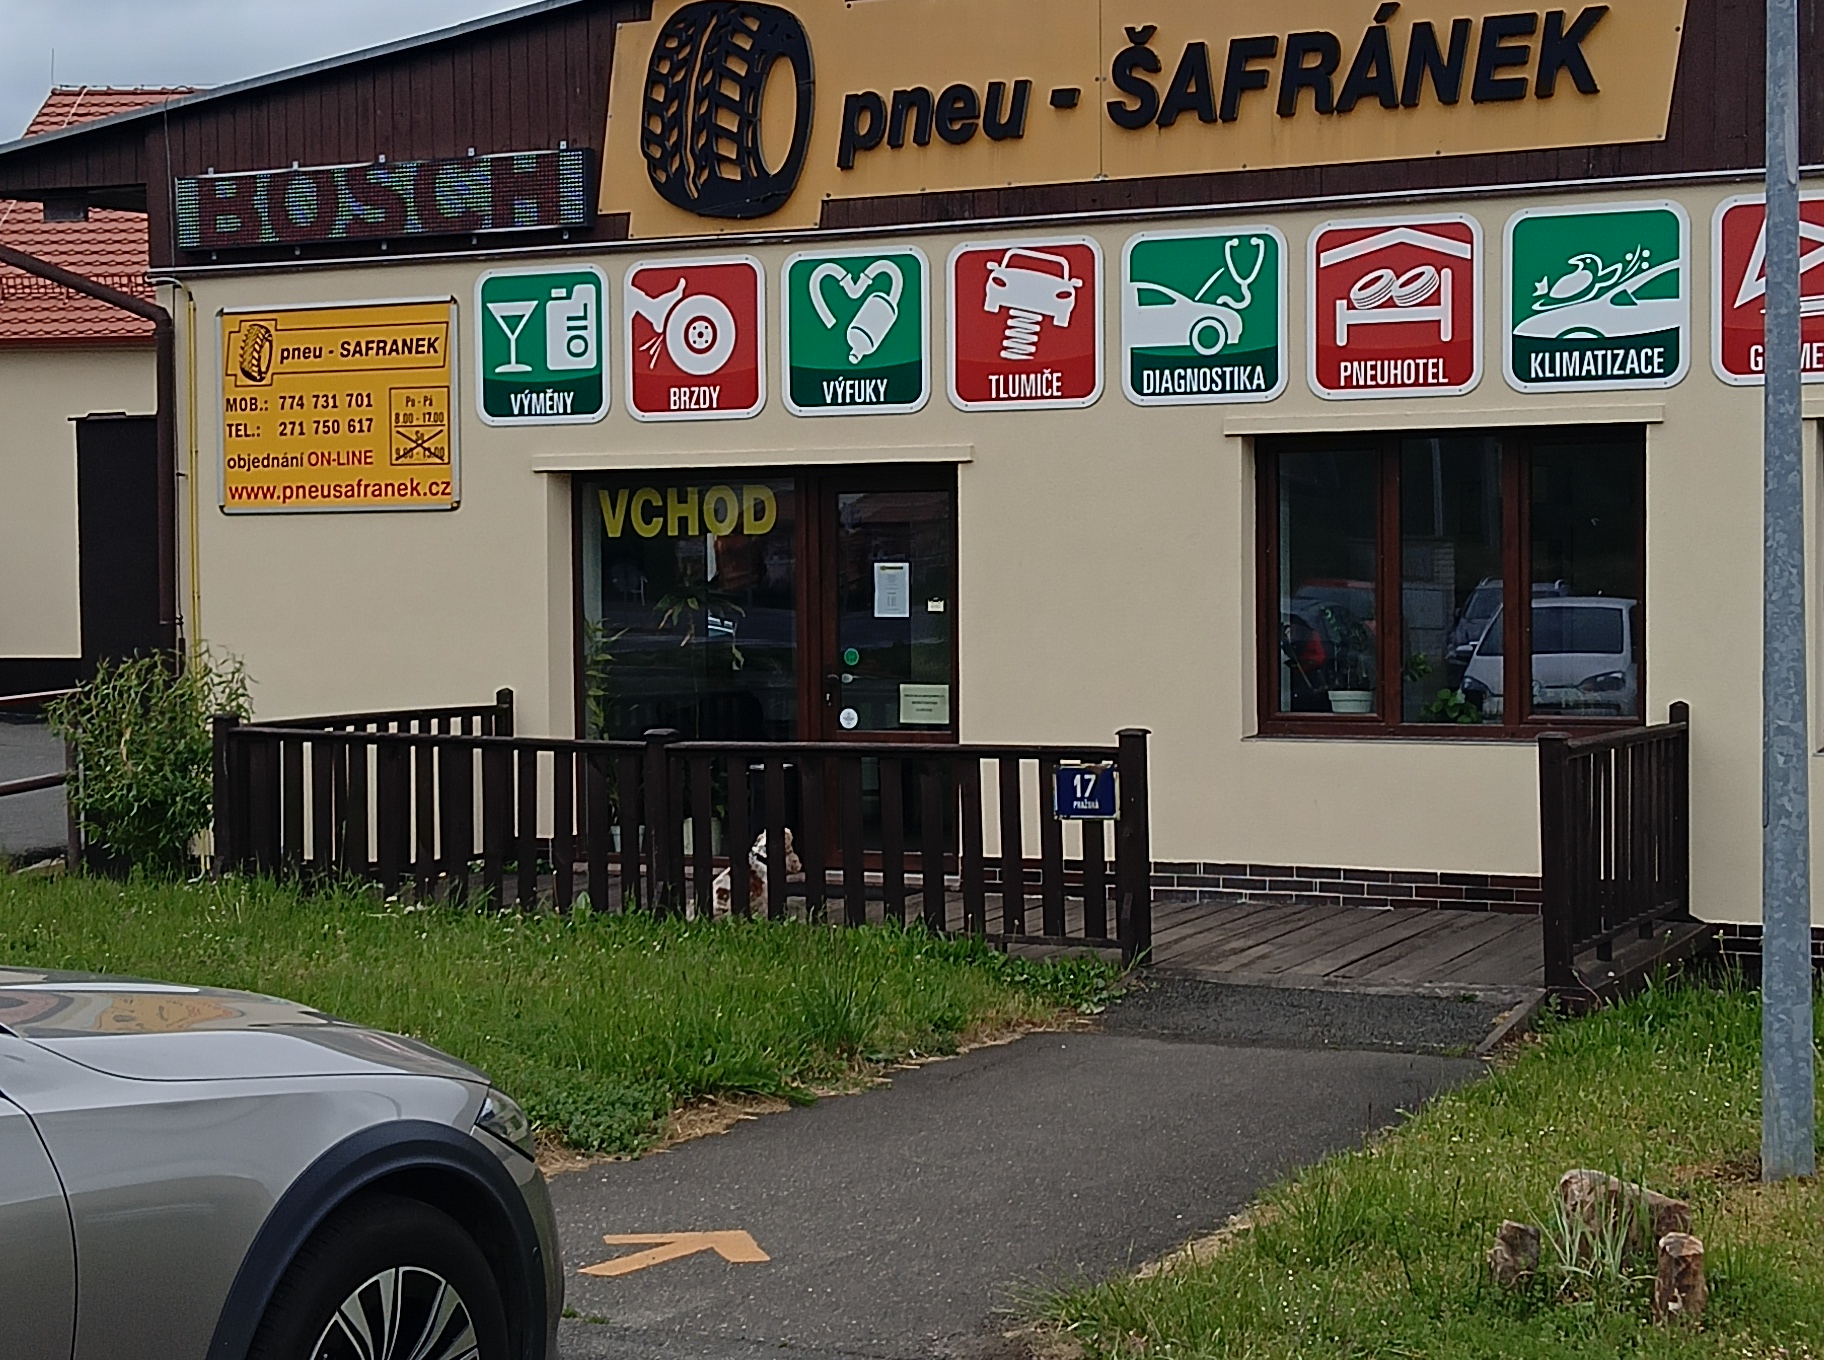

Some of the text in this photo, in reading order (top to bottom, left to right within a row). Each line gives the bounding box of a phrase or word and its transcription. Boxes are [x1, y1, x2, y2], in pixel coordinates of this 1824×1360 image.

[837, 1, 1610, 170] pneu - ŠAFRÁNEK
[198, 151, 560, 247] BOSCH
[566, 303, 588, 358] OIL
[280, 346, 323, 364] pneu
[340, 337, 440, 358] SAFRANEK
[1530, 347, 1664, 378] KLIMATIZACE
[988, 369, 1062, 399] TLUMIČE
[1143, 366, 1266, 395] DIAGNOSTIKA
[1340, 357, 1448, 386] PNEUHOTEL
[226, 393, 373, 412] MOB.: 774 731 701
[510, 389, 574, 415] VÝMĚNY
[669, 385, 720, 410] BRZDY
[822, 376, 888, 405] VÝFUKY
[227, 418, 373, 438] TEL.: 271 750 617
[227, 450, 373, 472] objednání ON-LINE
[228, 478, 451, 503] www.pneusafranek.cz
[599, 485, 777, 537] VCHOD
[1074, 774, 1096, 797] 17
